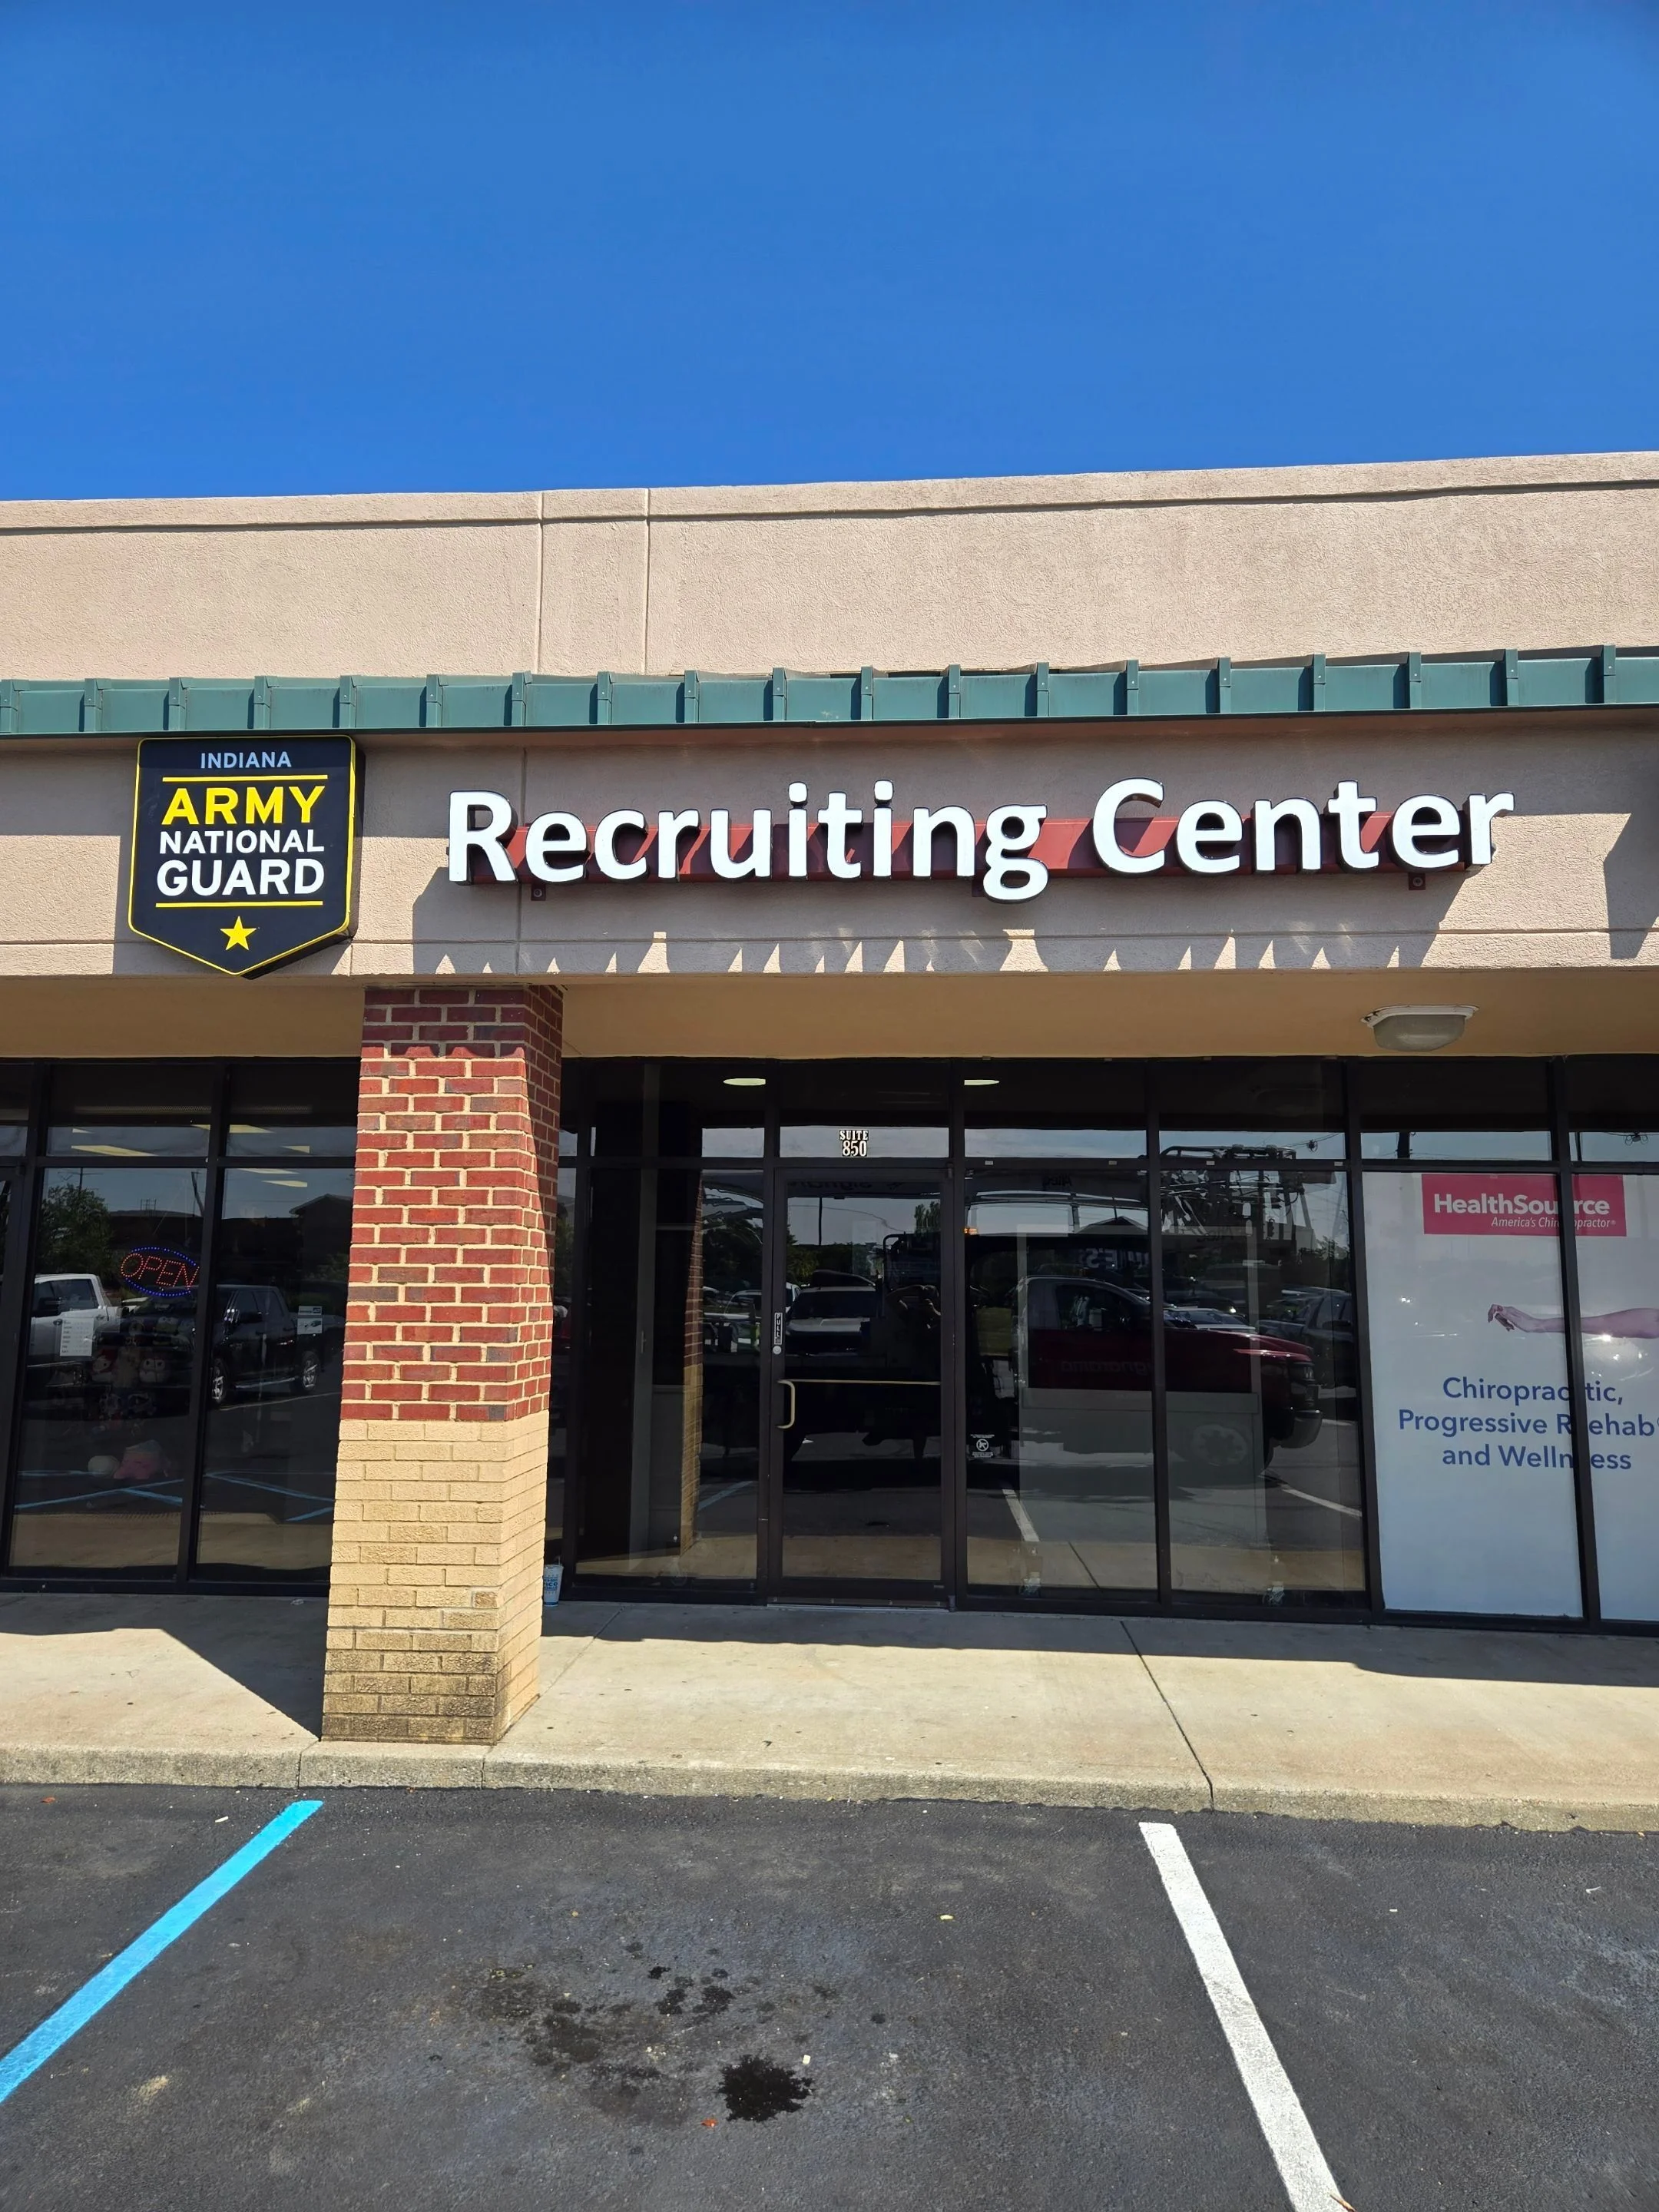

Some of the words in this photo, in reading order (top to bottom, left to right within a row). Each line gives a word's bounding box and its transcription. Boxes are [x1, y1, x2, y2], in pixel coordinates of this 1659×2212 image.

[200, 751, 292, 769] INDIANA
[161, 786, 326, 825] ARMY
[159, 829, 325, 854] NATIONAL
[449, 780, 1048, 904] Recruiting
[1092, 777, 1515, 874] Center
[157, 858, 325, 896] GUARD
[839, 1130, 869, 1141] SUITE
[842, 1140, 867, 1157] 850
[1434, 1193, 1610, 1215] HealthSource
[1491, 1217, 1536, 1227] America's
[121, 1253, 200, 1292] OPEN
[1442, 1376, 1623, 1406] Chiropractic,
[1399, 1409, 1548, 1438] Progressive
[1442, 1444, 1490, 1465] and
[1498, 1445, 1631, 1470] Wellness
